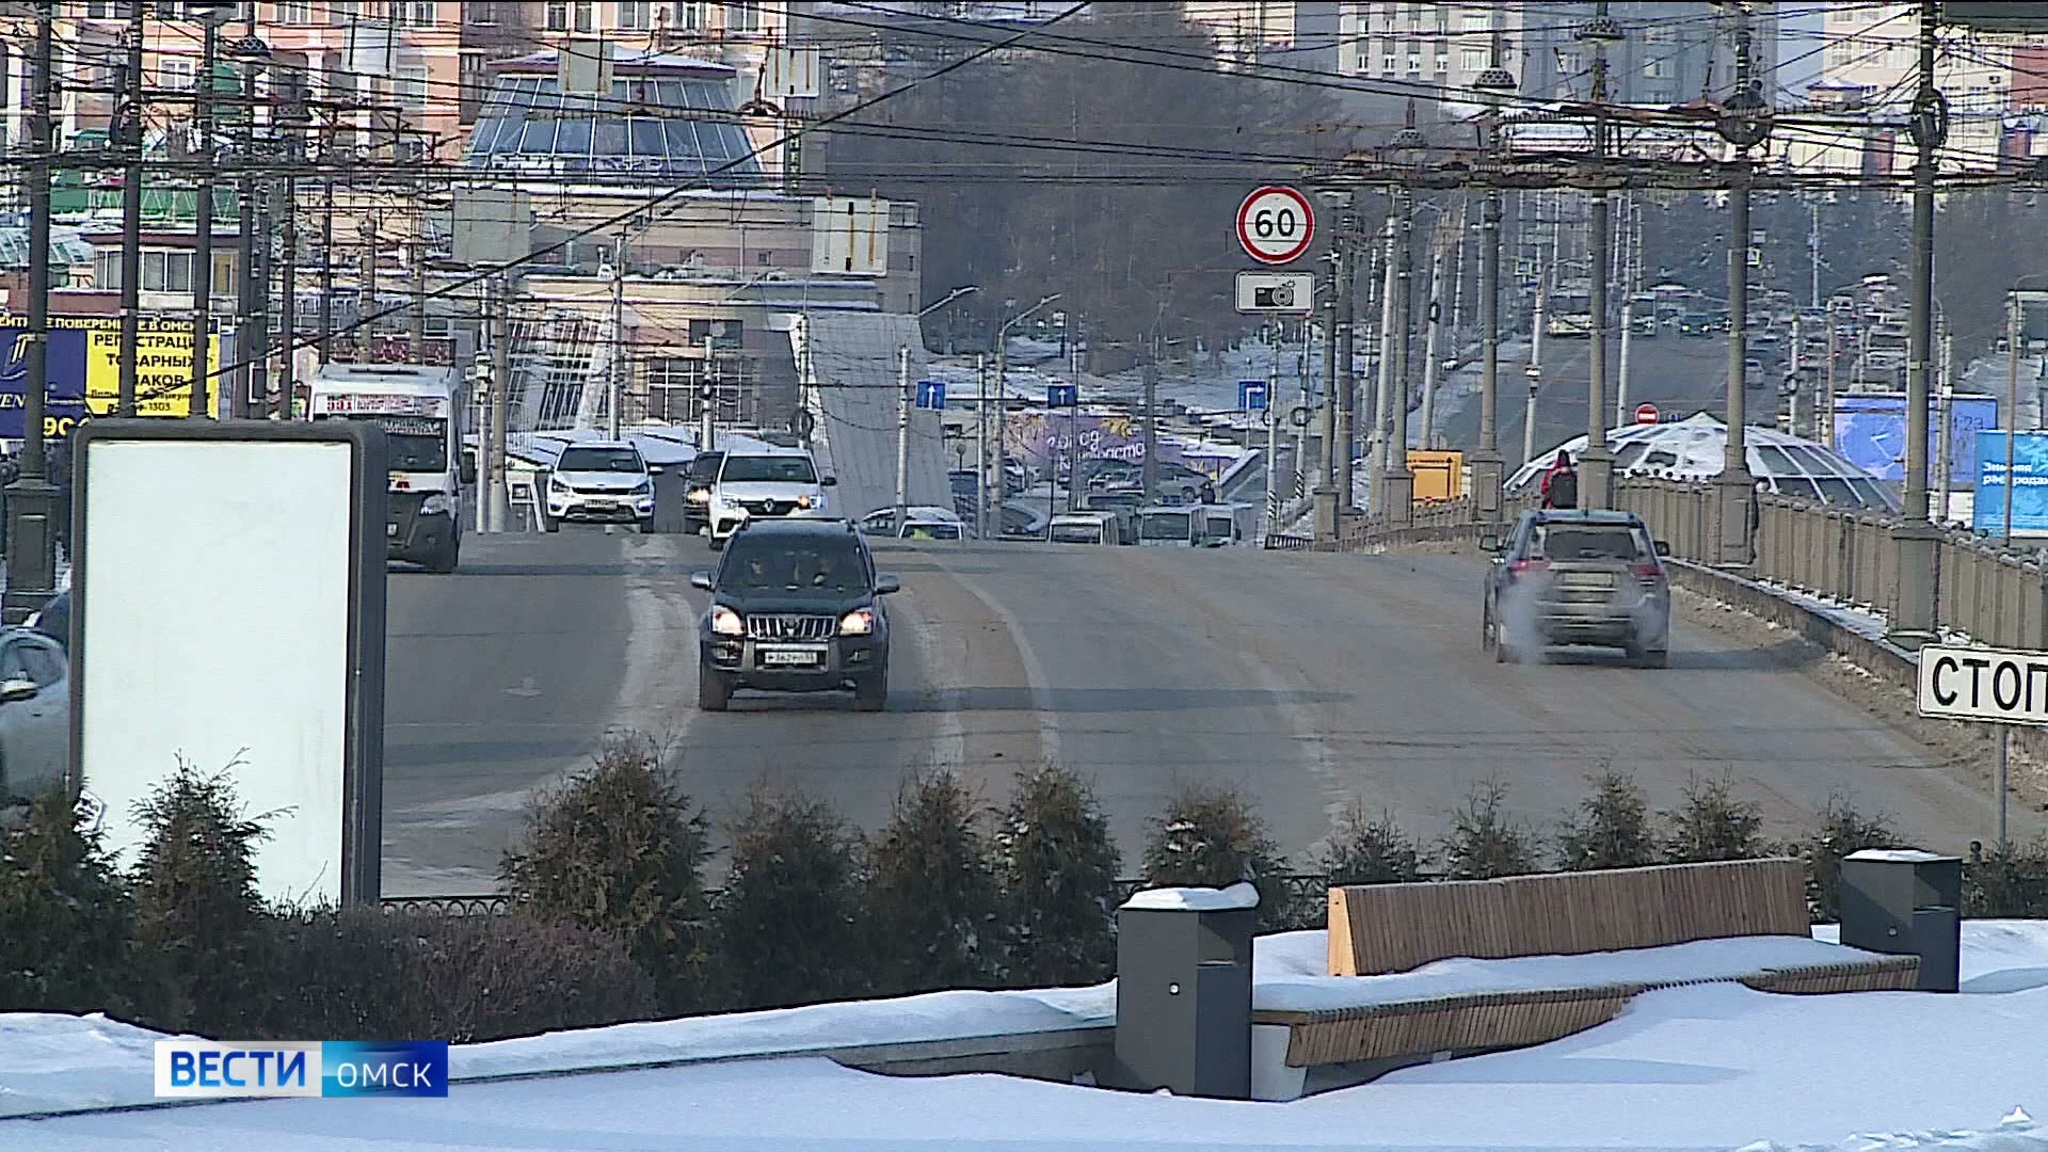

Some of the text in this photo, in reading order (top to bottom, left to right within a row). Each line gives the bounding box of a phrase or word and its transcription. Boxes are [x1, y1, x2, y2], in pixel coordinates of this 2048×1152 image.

[1255, 208, 1296, 238] 60
[106, 352, 196, 367] ТОАРНЫХ
[1932, 656, 2048, 713] СТОП
